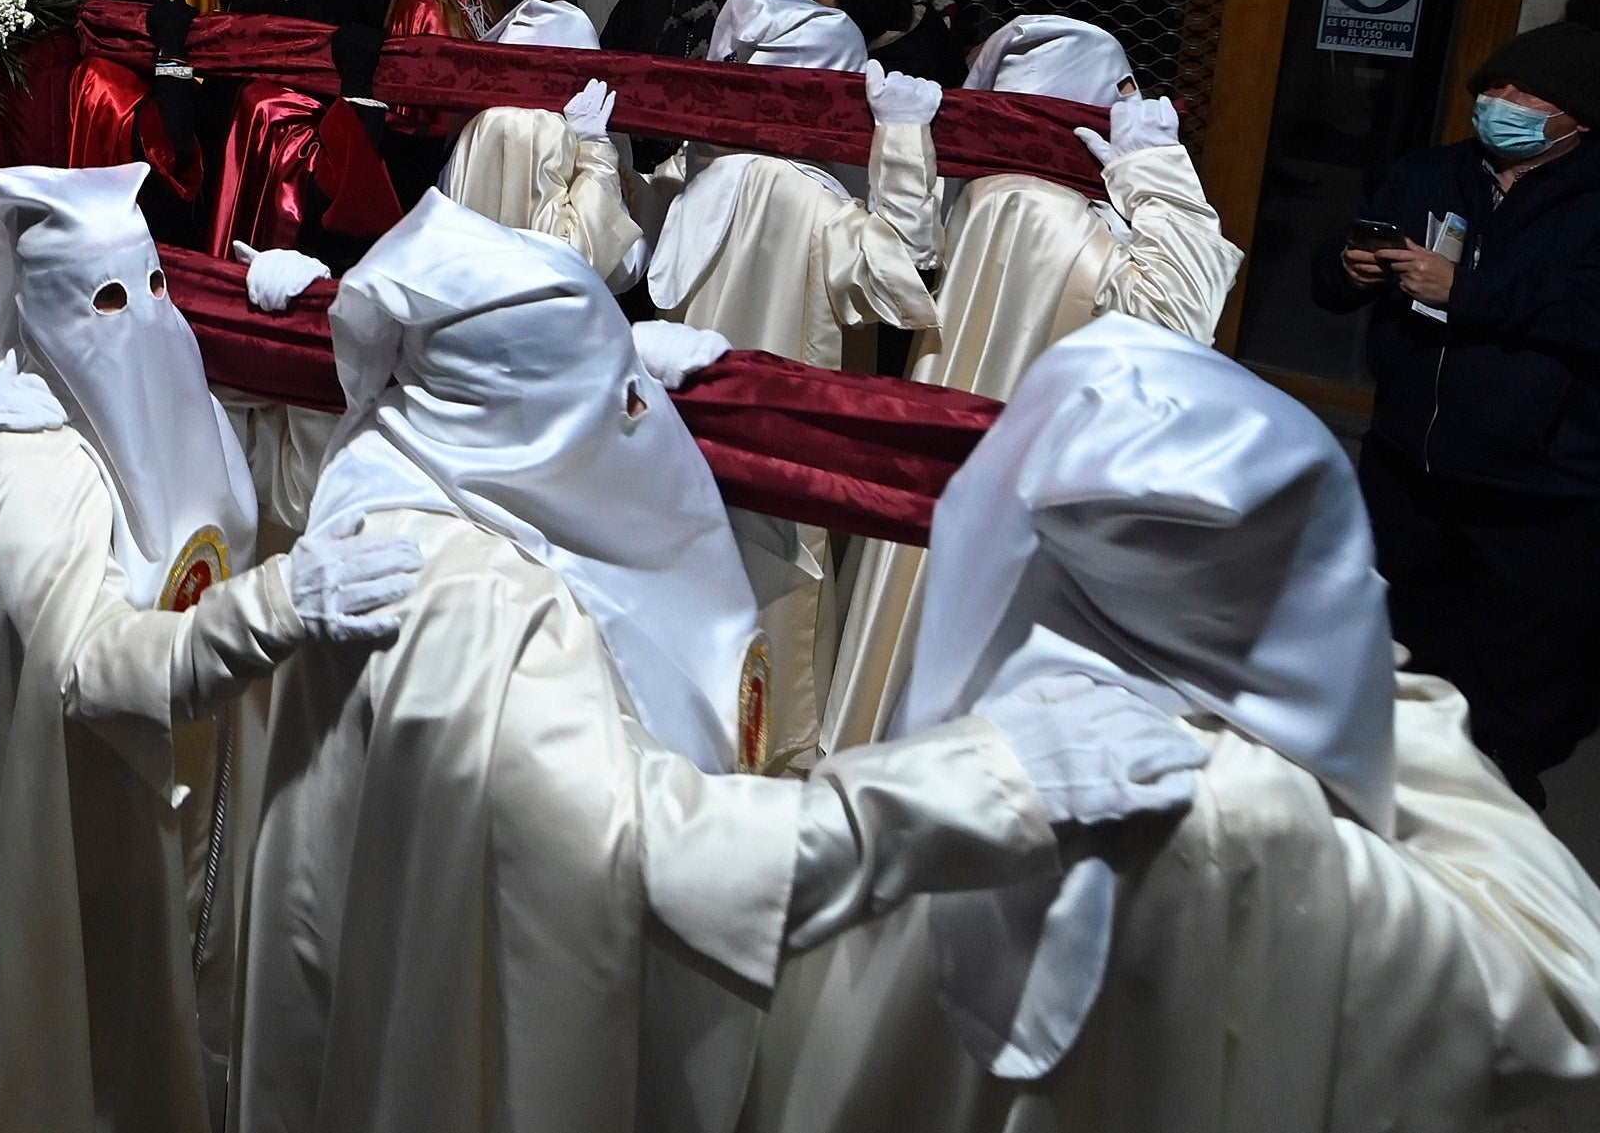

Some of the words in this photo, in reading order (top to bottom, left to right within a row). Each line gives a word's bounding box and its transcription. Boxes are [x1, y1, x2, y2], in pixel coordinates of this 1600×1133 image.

[1326, 17, 1339, 27] ES
[1341, 18, 1412, 33] OBLIGATORIO
[1347, 28, 1357, 37] EL
[1361, 29, 1383, 40] USO
[1324, 35, 1339, 45] DE
[1340, 36, 1407, 52] MASCARILLA
